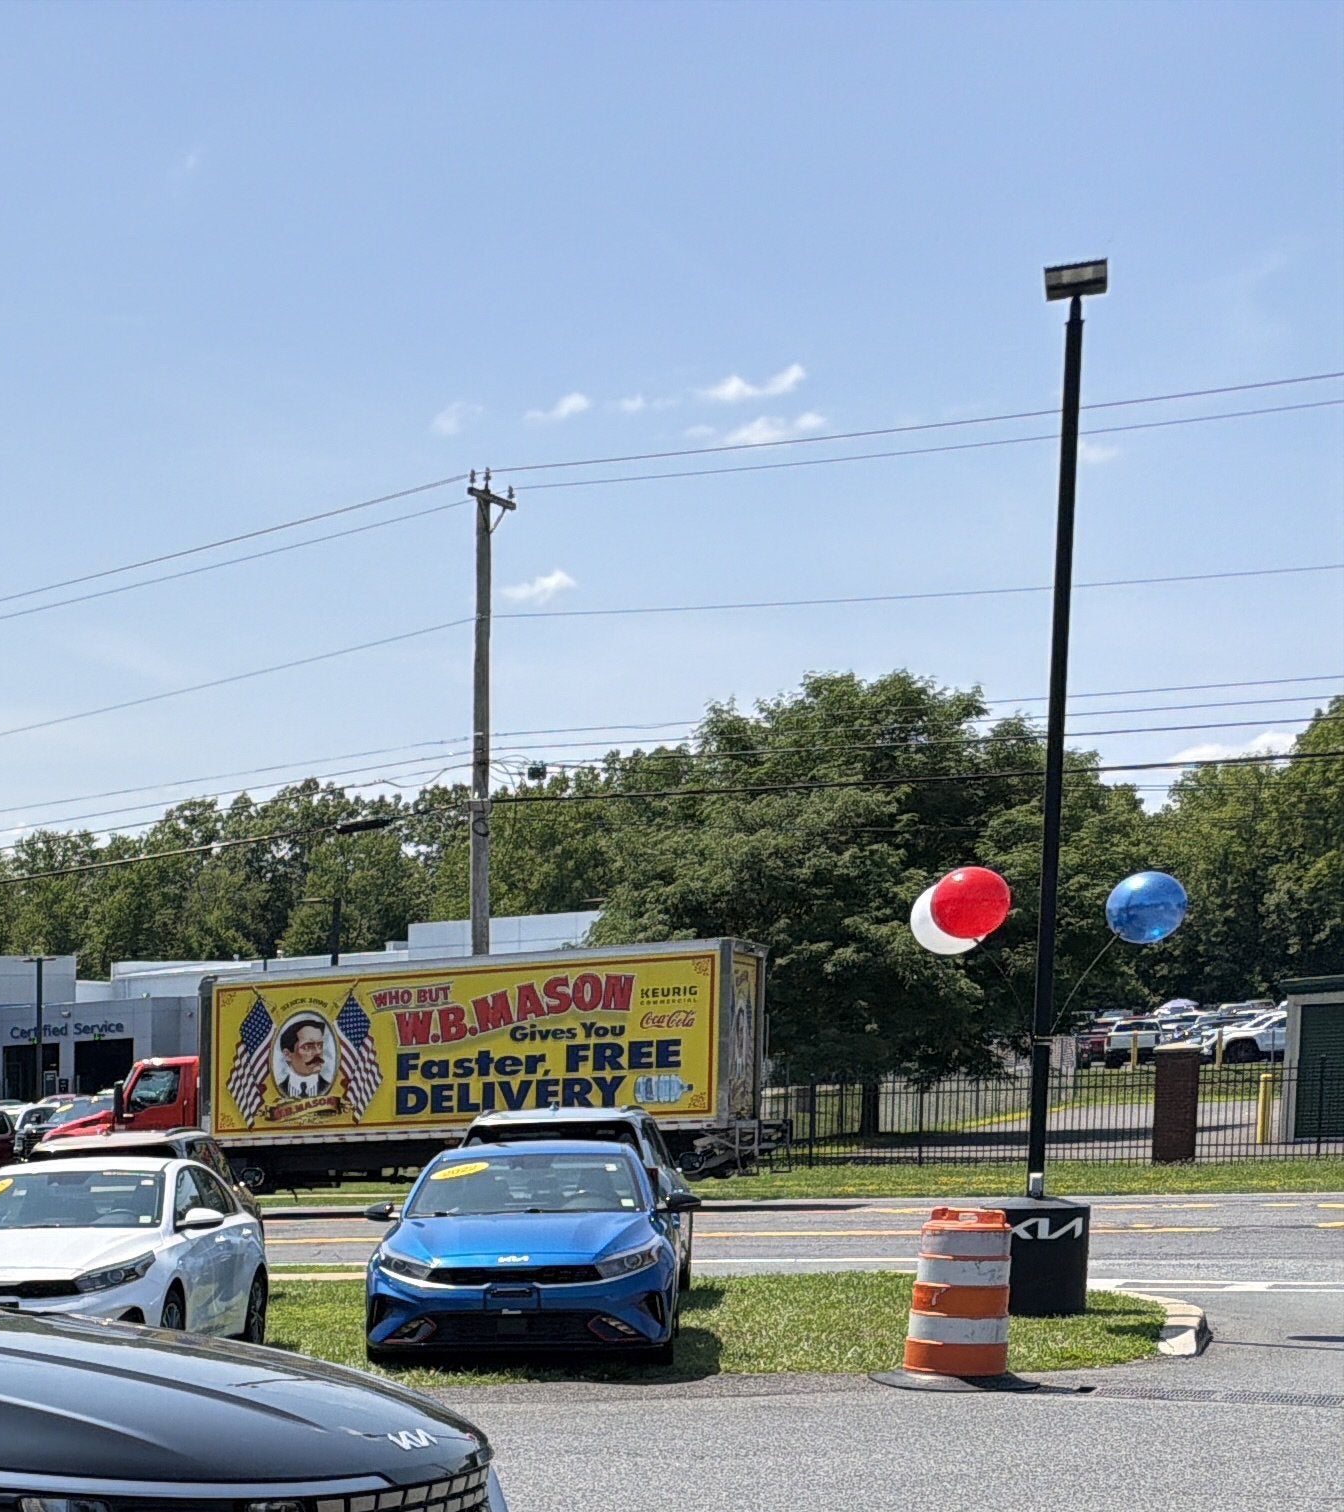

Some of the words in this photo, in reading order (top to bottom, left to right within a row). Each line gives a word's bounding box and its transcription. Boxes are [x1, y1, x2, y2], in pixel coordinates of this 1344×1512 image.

[372, 988, 413, 1009] WHO
[416, 984, 451, 1003] BUT
[639, 997, 698, 1007] COMMERCIAL
[640, 985, 699, 1000] KEURIG
[394, 971, 635, 1047] W.B.MASON
[73, 1020, 124, 1035] Service
[509, 1023, 578, 1042] Gives
[580, 1021, 626, 1038] You
[395, 1049, 551, 1082] Faster,
[564, 1038, 682, 1074] FREE
[394, 1074, 627, 1116] DELIVERY
